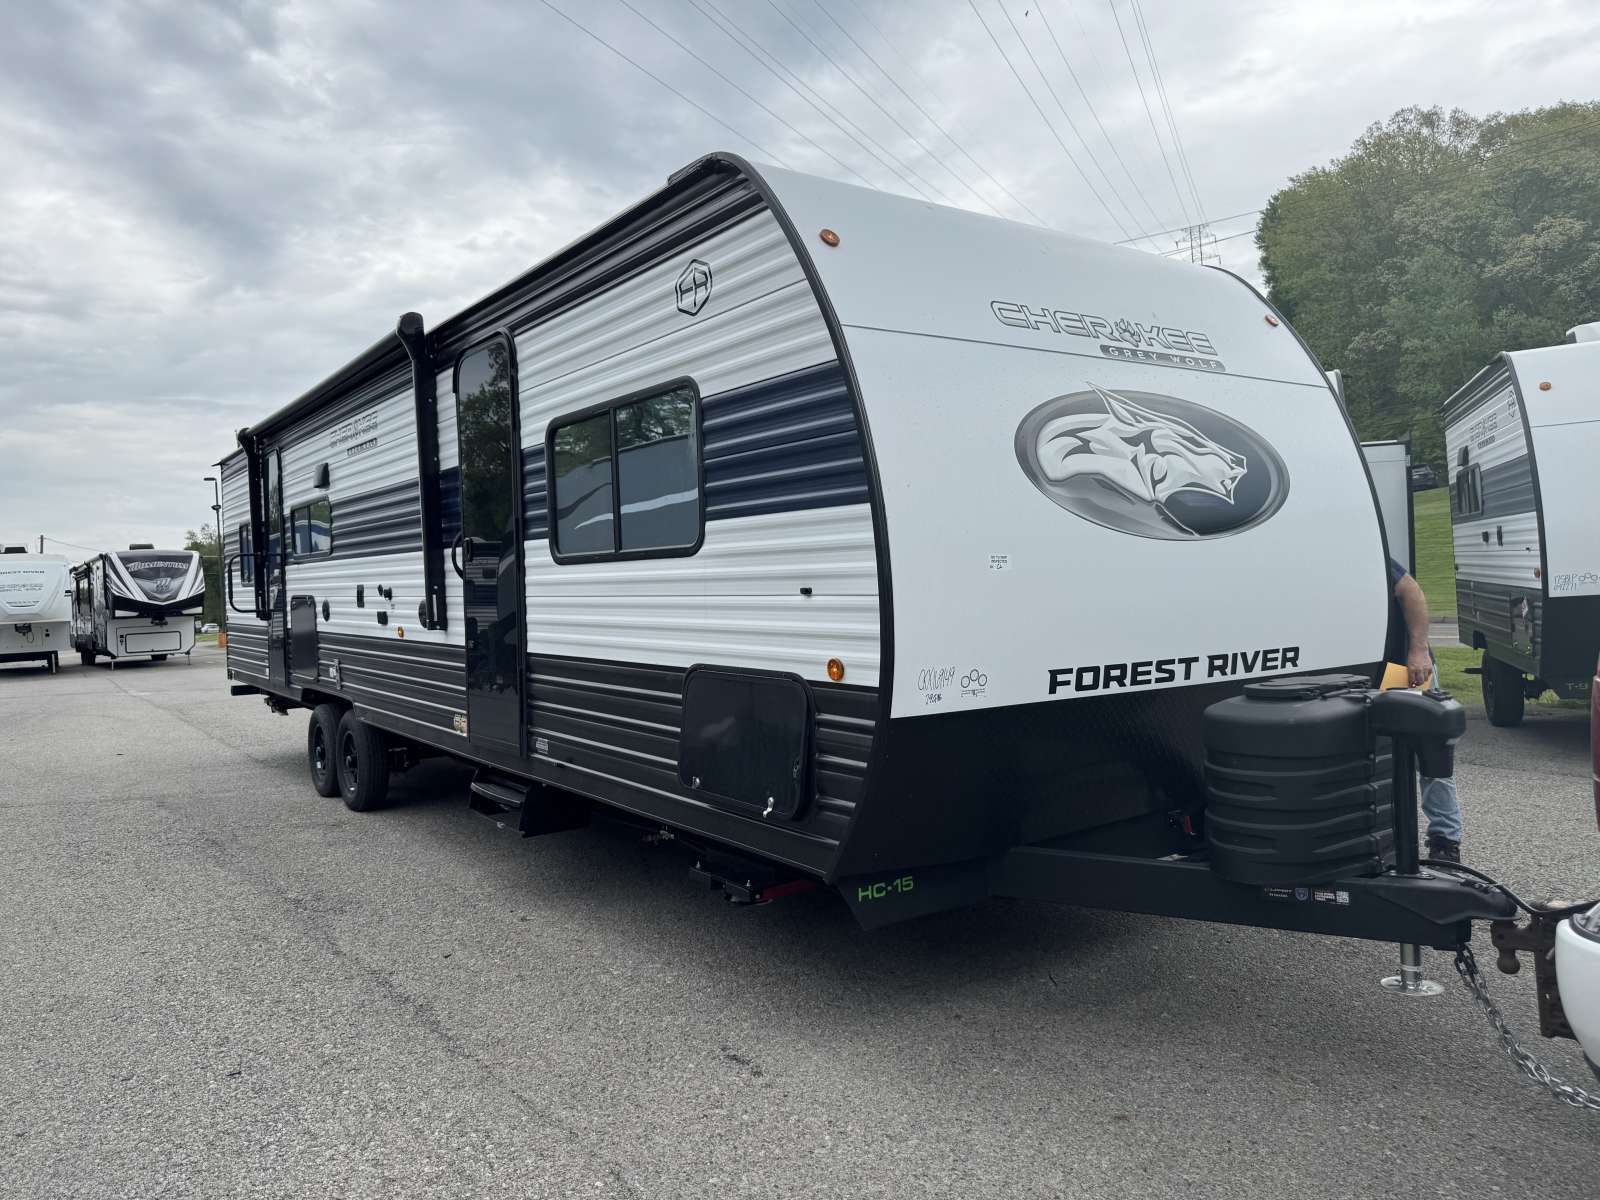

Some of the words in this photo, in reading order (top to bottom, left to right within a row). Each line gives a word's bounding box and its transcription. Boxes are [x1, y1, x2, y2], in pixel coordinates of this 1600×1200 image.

[990, 300, 1218, 356] CHEROKEE
[1108, 346, 1158, 361] GREY
[1169, 354, 1218, 369] WOLF
[1047, 656, 1200, 695] FOREST
[1206, 646, 1300, 678] RIVER
[858, 875, 914, 902] HC-15
